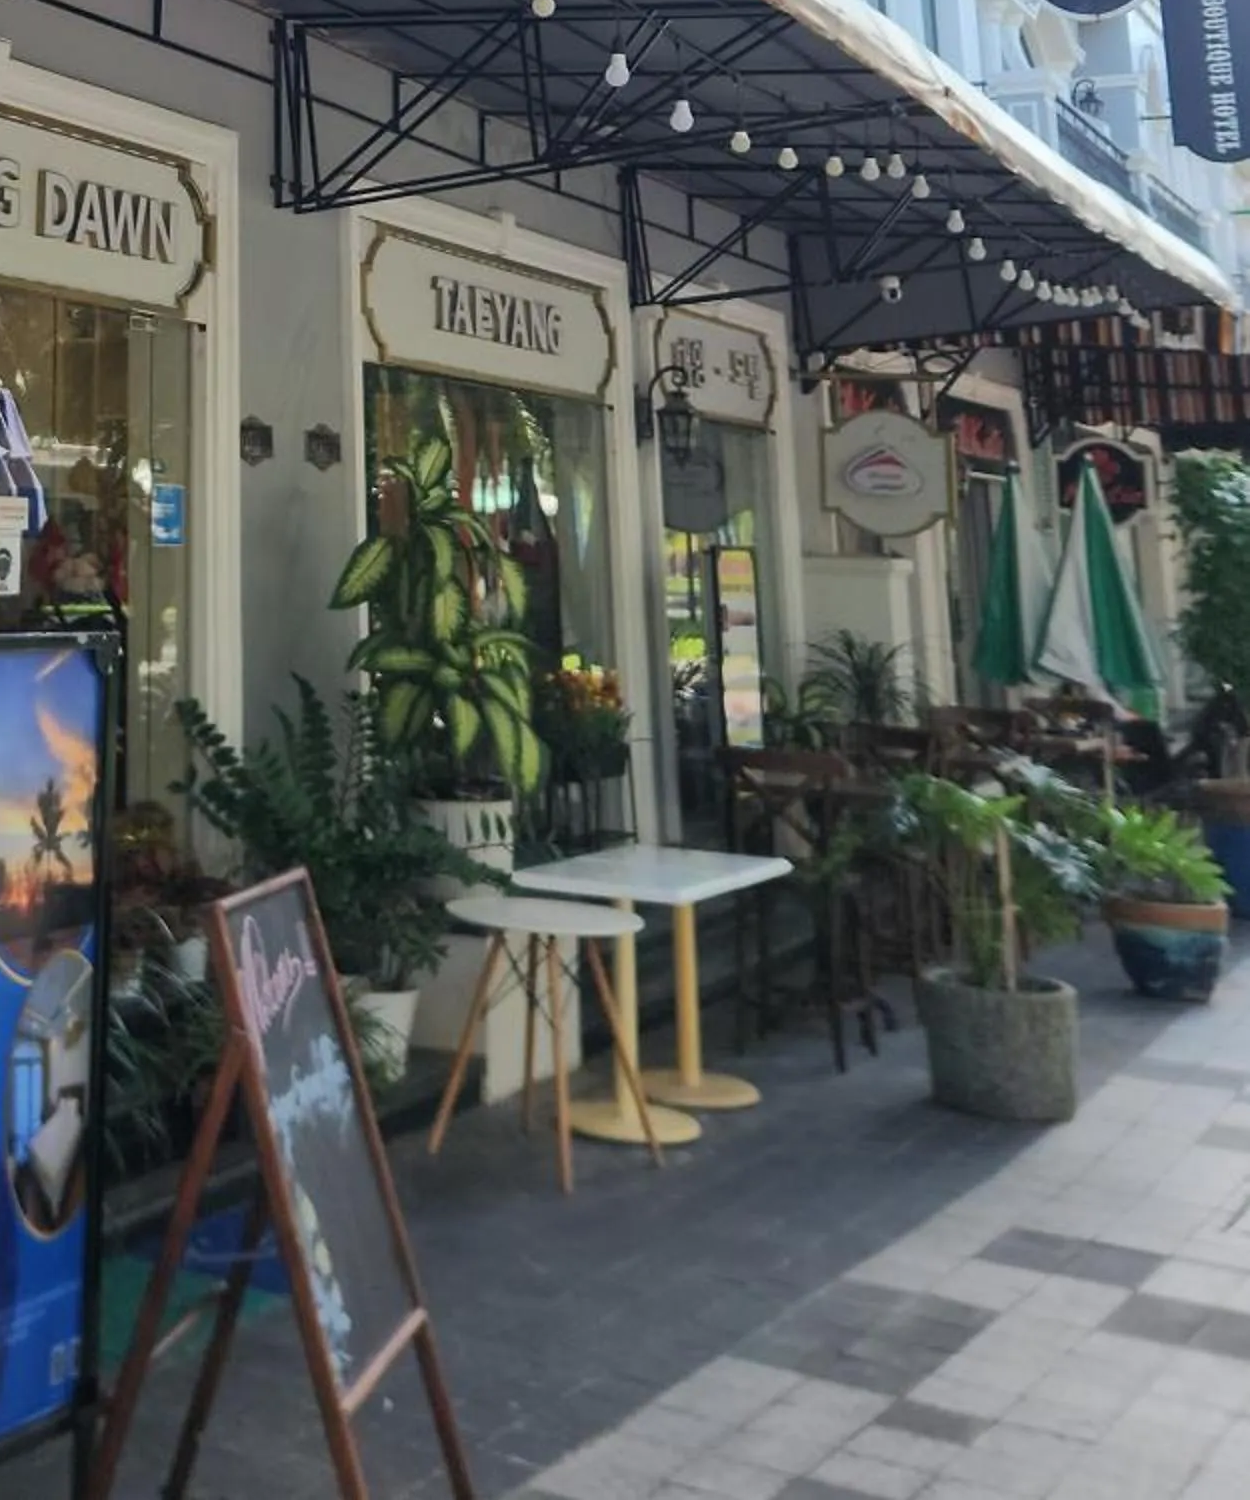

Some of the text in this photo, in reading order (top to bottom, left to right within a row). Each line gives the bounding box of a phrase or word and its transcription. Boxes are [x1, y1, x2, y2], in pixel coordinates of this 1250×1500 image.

[1211, 93, 1242, 155] HOTEL
[37, 169, 178, 265] DAWN
[430, 275, 563, 356] TAEYANG
